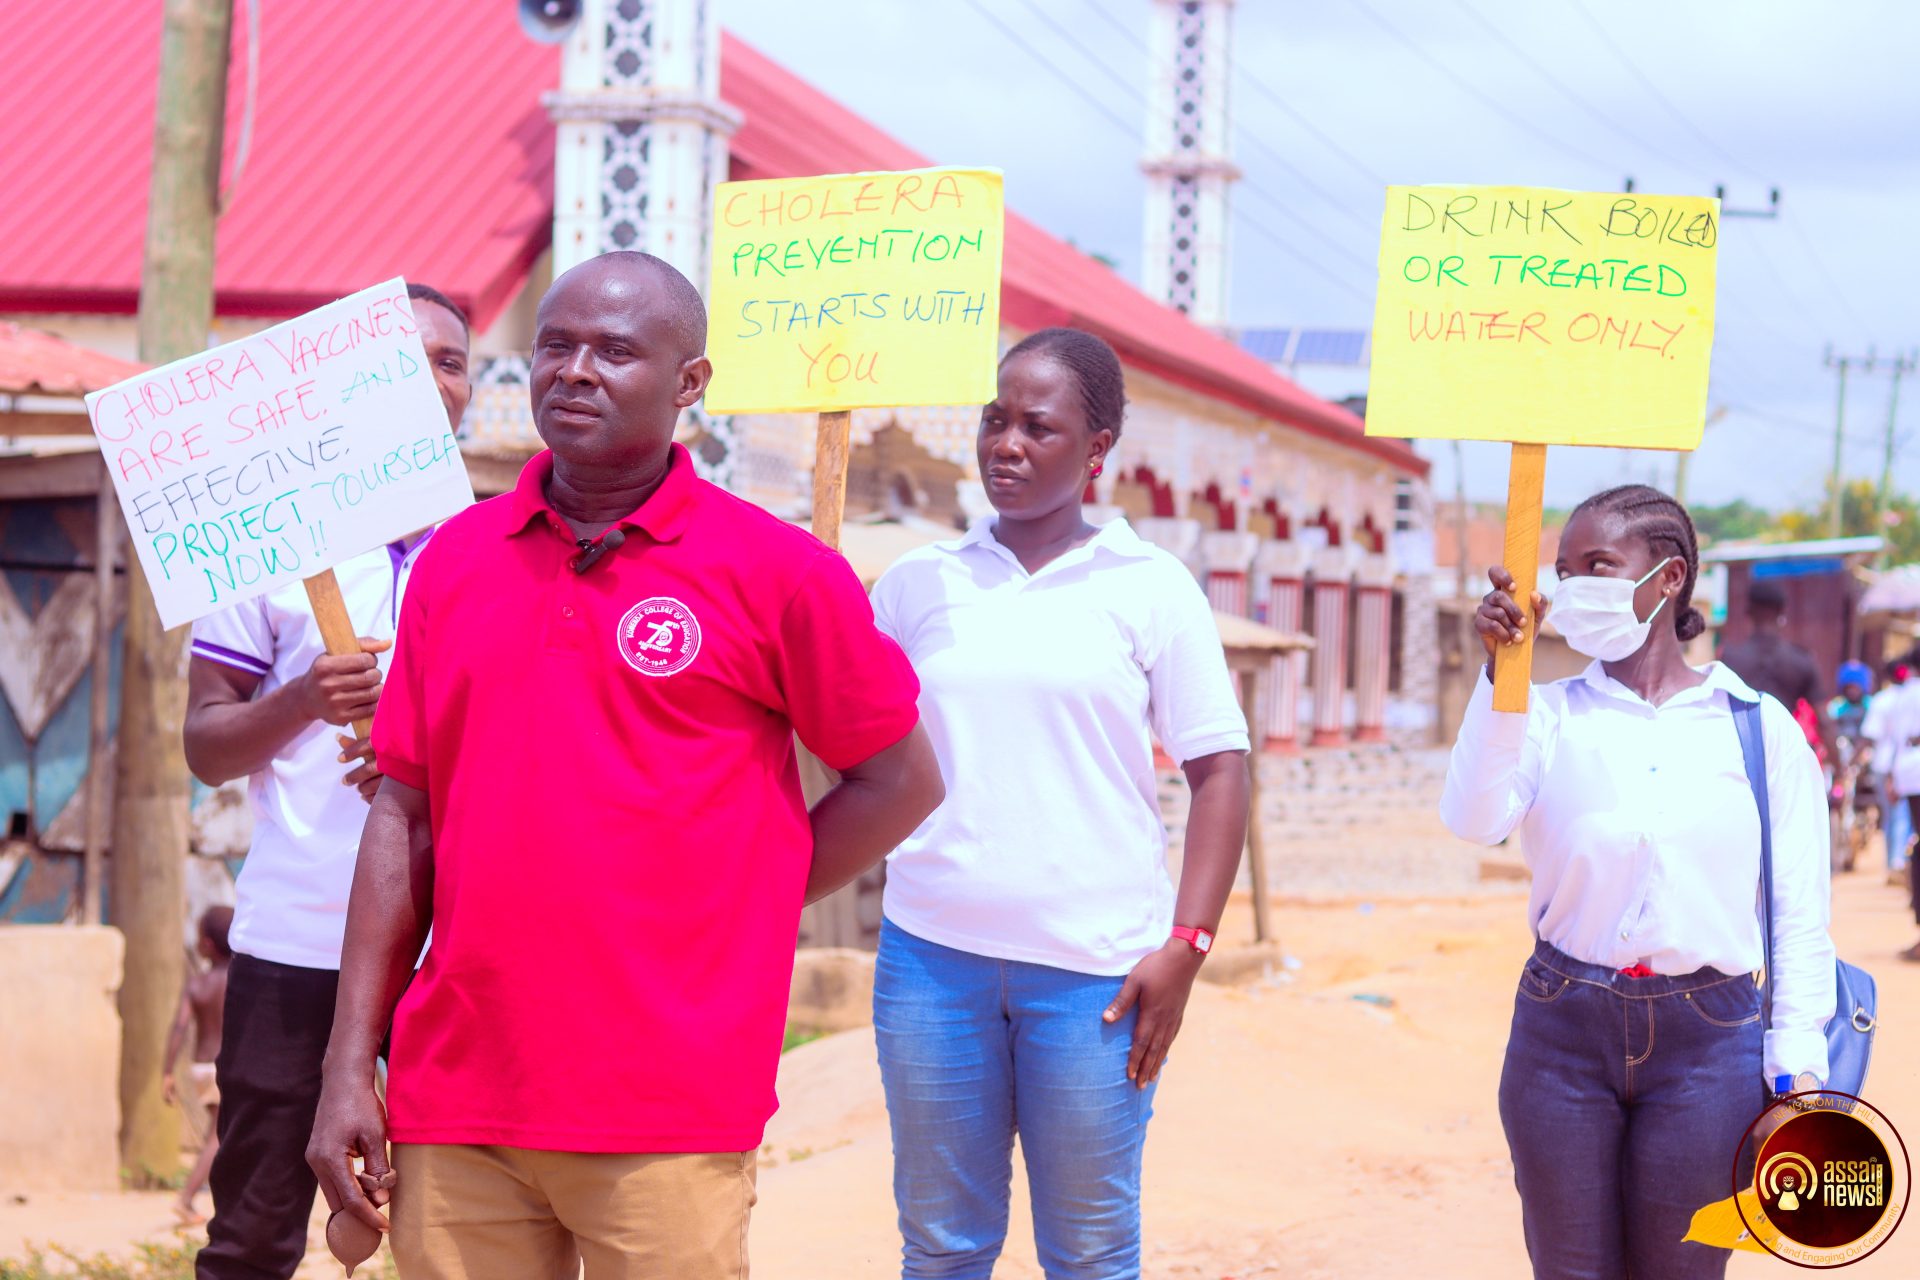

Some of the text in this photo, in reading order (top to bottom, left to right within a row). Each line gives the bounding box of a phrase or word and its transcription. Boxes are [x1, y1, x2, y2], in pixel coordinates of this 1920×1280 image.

[725, 176, 964, 227] CHOLERA
[1403, 194, 1716, 248] DRINK BOILED
[733, 230, 982, 276] PREVENTION
[1404, 255, 1687, 296] OR TREATED
[737, 291, 985, 338] STARTS WITH
[1409, 311, 1684, 360] WATER ONLY.
[95, 295, 418, 441] CHOLERA VACCINES
[798, 343, 878, 387] YOU
[118, 424, 209, 481] ARE
[341, 349, 418, 403] AND
[153, 490, 302, 580] PROTECT
[644, 606, 674, 615] COLLEGE
[673, 612, 683, 620] OF
[680, 620, 691, 654] EDUCATION
